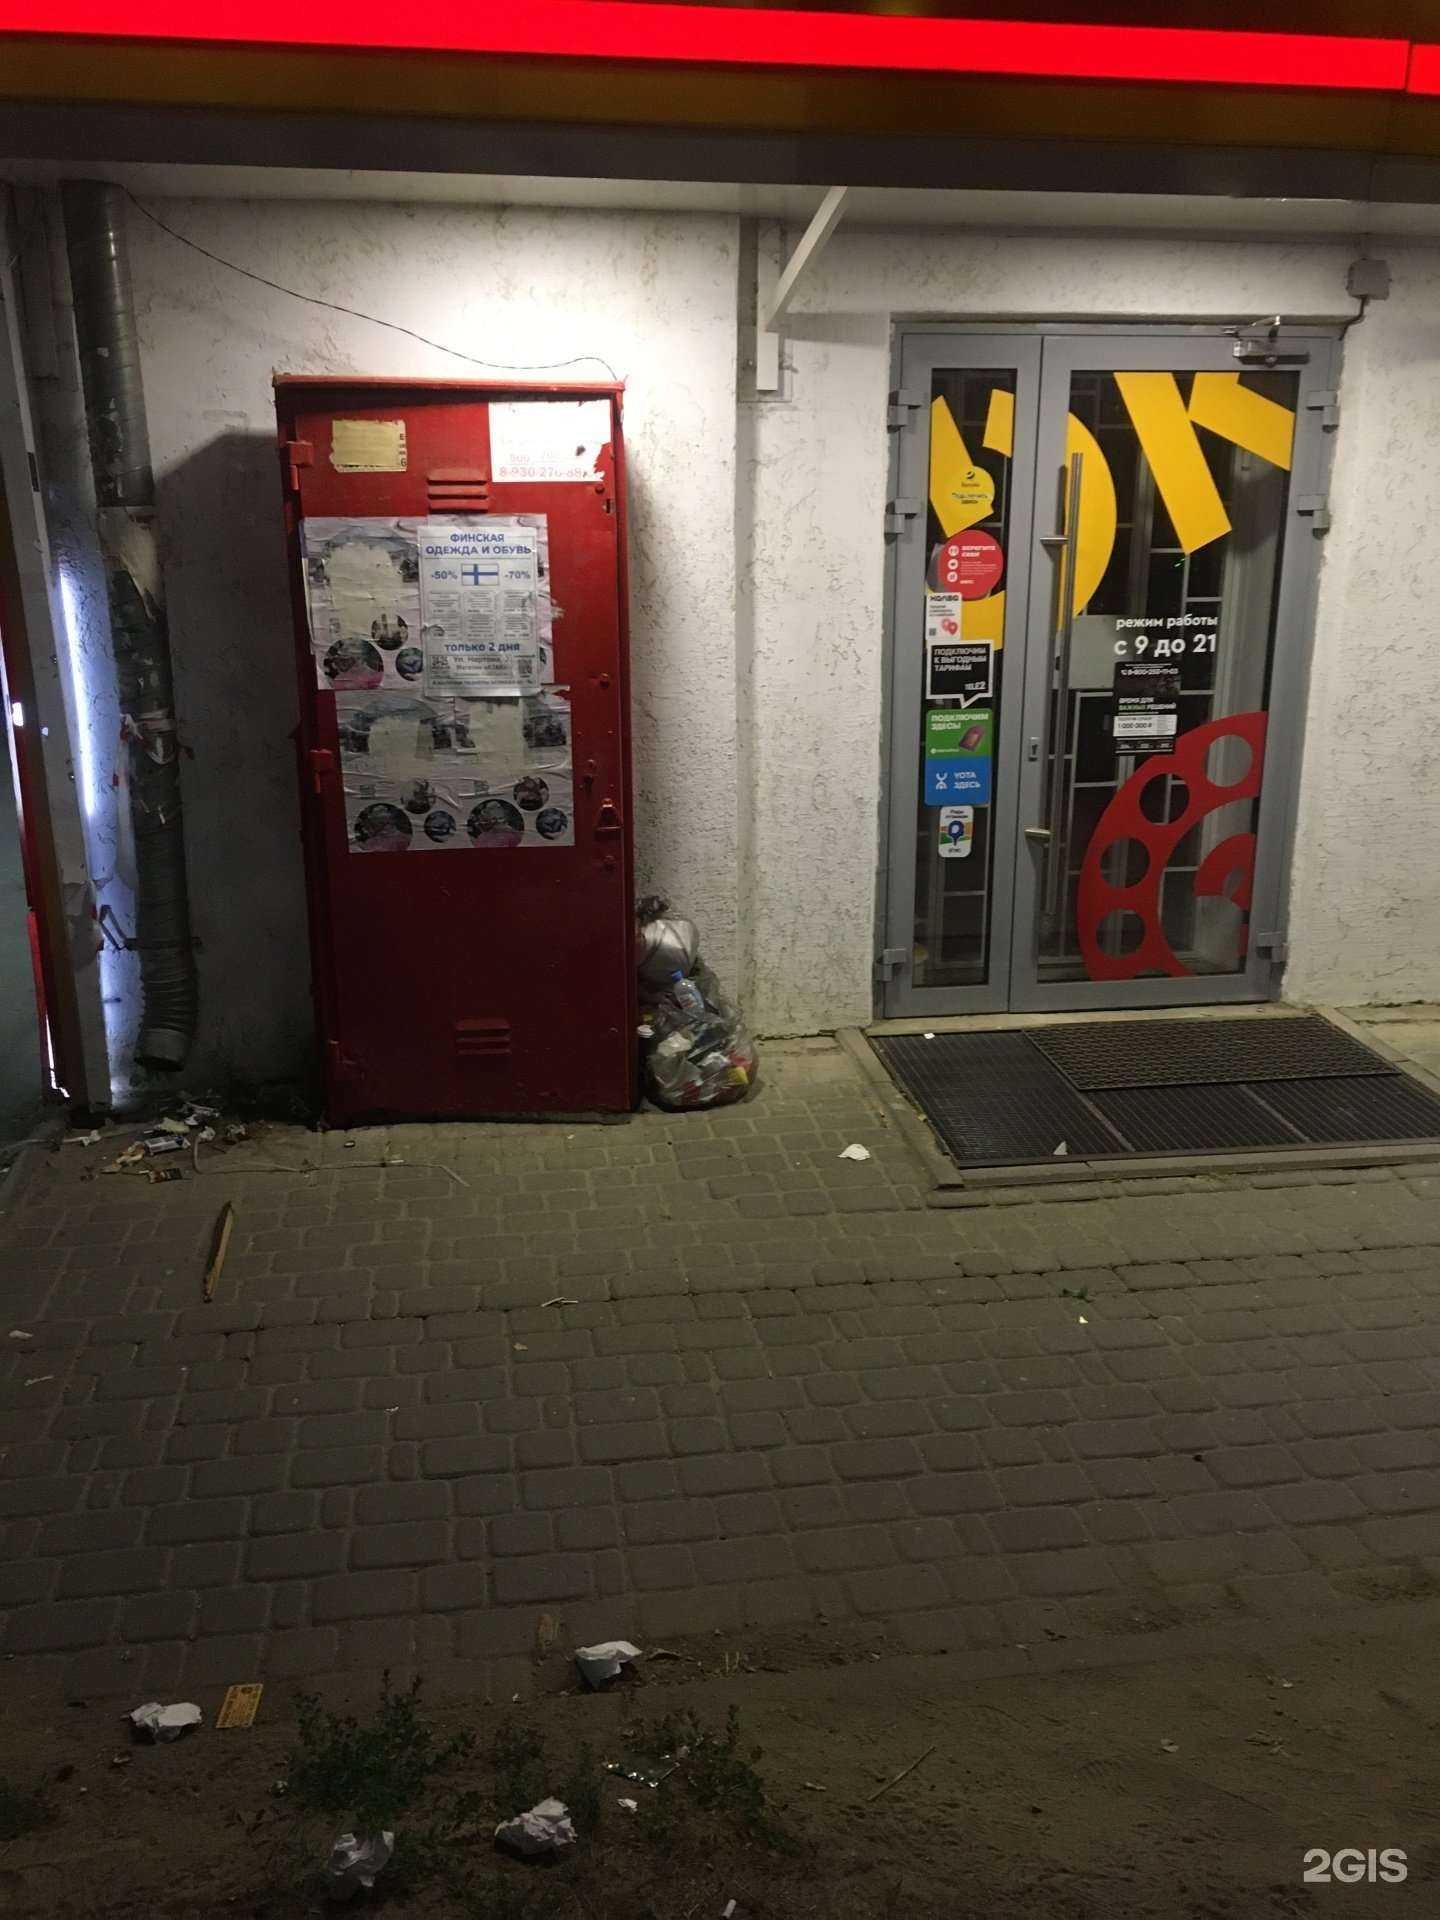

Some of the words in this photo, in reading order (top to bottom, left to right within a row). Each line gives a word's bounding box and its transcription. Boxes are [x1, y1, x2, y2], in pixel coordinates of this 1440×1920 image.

[450, 533, 505, 543] ФИНСКАЯ
[425, 545, 479, 556] ОДЕЖДА
[481, 546, 491, 554] И
[493, 545, 532, 555] ОБУВЬ
[431, 569, 459, 580] -50%
[504, 569, 532, 580] -70%
[1116, 618, 1164, 631] режим
[1166, 613, 1219, 629] работы
[488, 642, 496, 652] 2
[498, 643, 520, 653] дня
[1135, 635, 1149, 655] 9
[1153, 638, 1186, 657] до
[1192, 633, 1217, 653] 21
